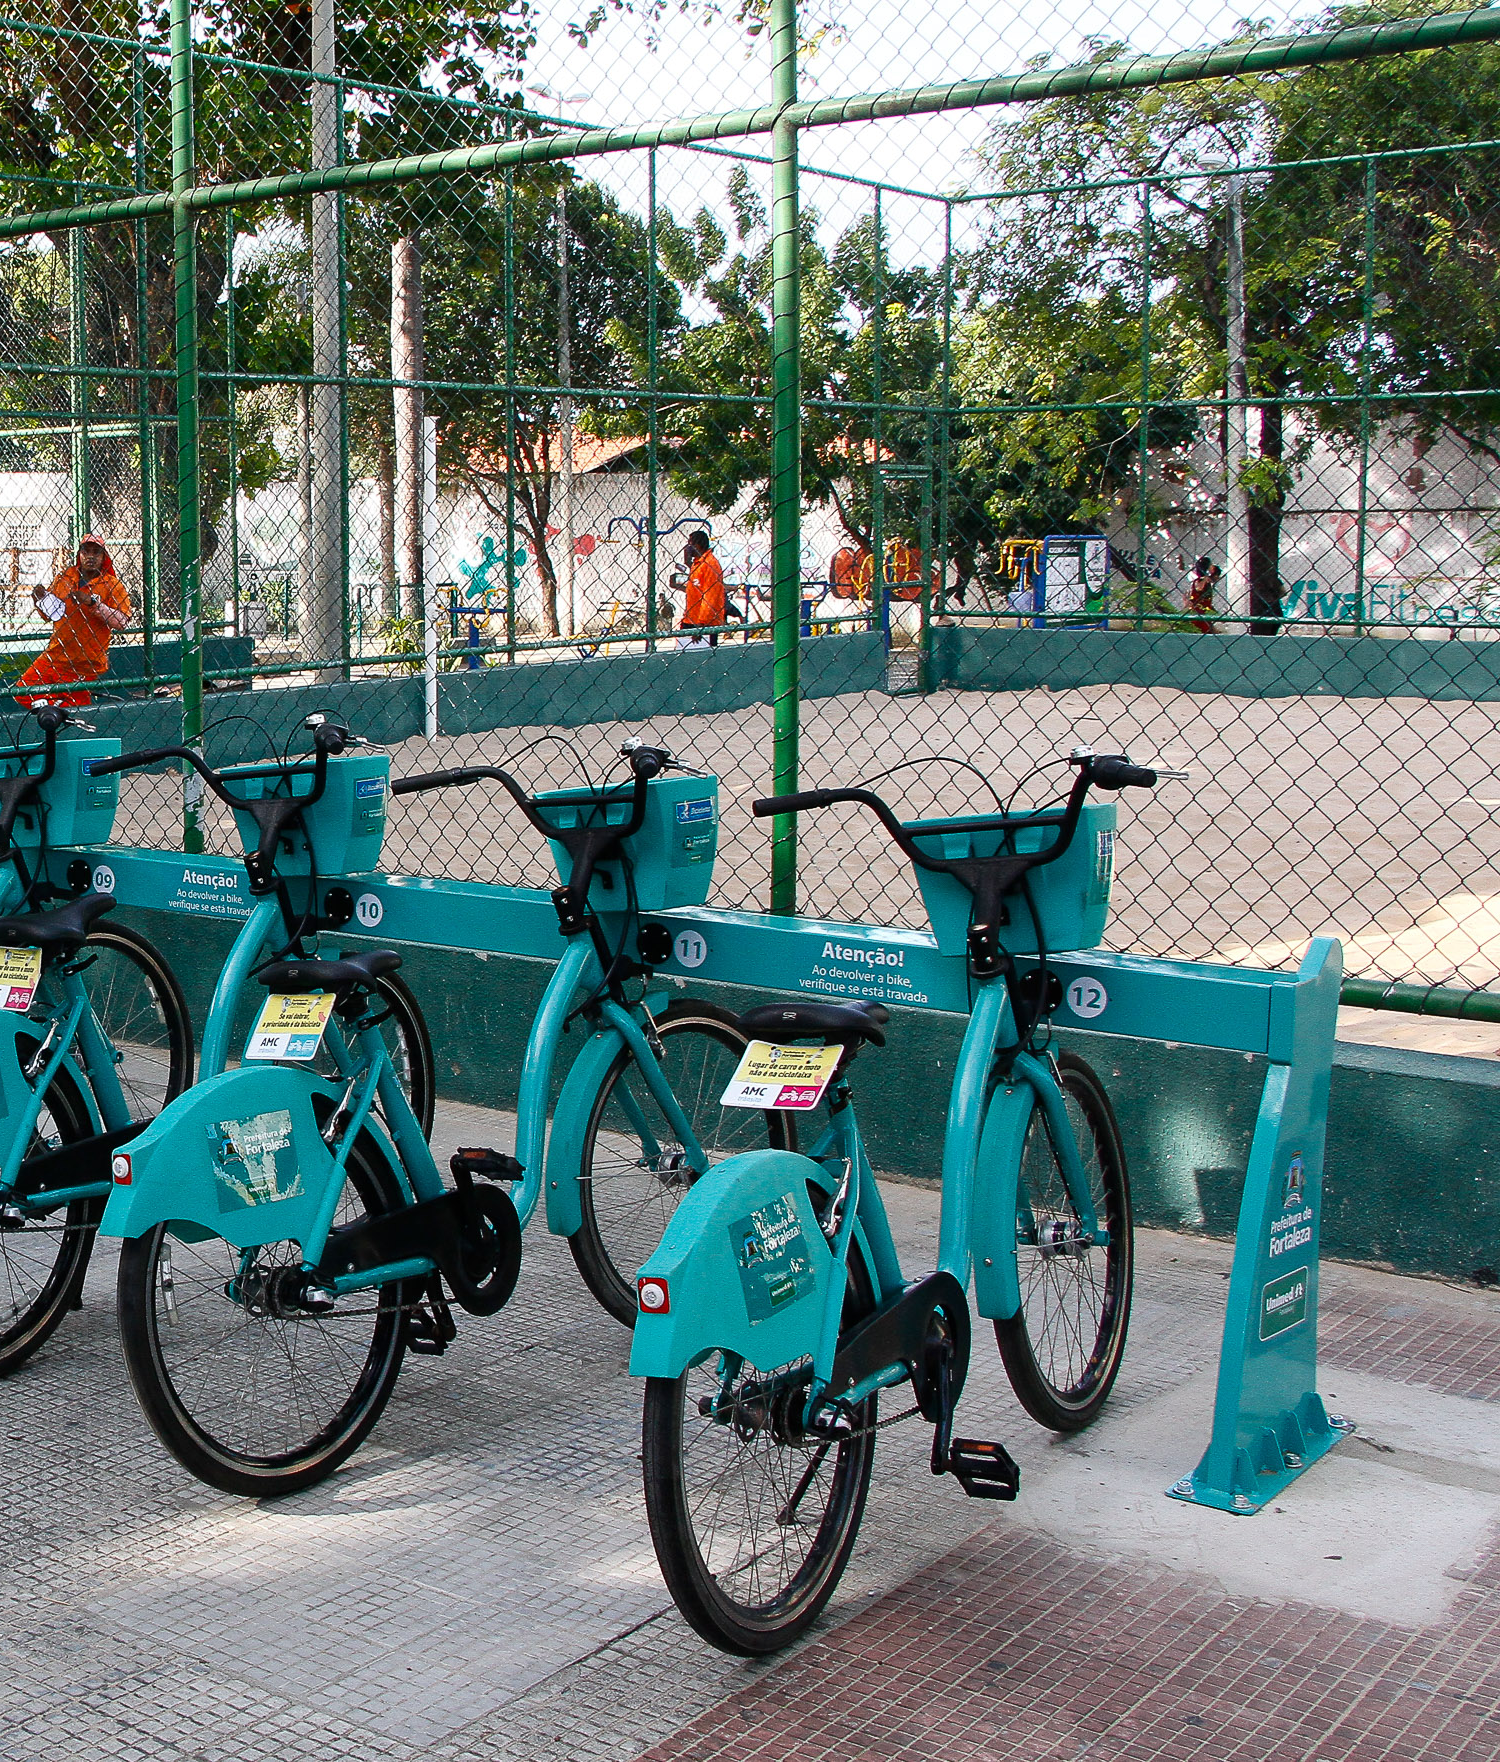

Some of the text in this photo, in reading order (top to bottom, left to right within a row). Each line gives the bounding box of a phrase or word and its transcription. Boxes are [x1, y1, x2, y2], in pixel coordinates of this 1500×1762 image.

[95, 872, 112, 888] 09
[182, 869, 238, 890] Atenção!
[176, 888, 186, 897] Ao
[188, 890, 220, 901] devolver
[226, 894, 244, 905] bike,
[168, 900, 200, 912] verifique
[210, 904, 226, 914] está
[360, 901, 378, 919] 10
[680, 940, 702, 960] 11
[821, 940, 904, 968] Atenção!
[812, 964, 913, 988] Ao devolver a bike,
[799, 978, 928, 1003] verifique se está travada
[1071, 986, 1100, 1010] 12
[260, 1037, 280, 1047] AMC
[748, 1060, 768, 1069] Lugar
[741, 1086, 768, 1096] AMC
[243, 1128, 288, 1142] Prefeitura de
[245, 1138, 290, 1155] Fortaleza
[1270, 1206, 1312, 1235] Prefeitura de
[763, 1226, 800, 1253] Fortaleza
[1269, 1226, 1312, 1258] Fortaleza
[1266, 1286, 1294, 1312] Unimed
